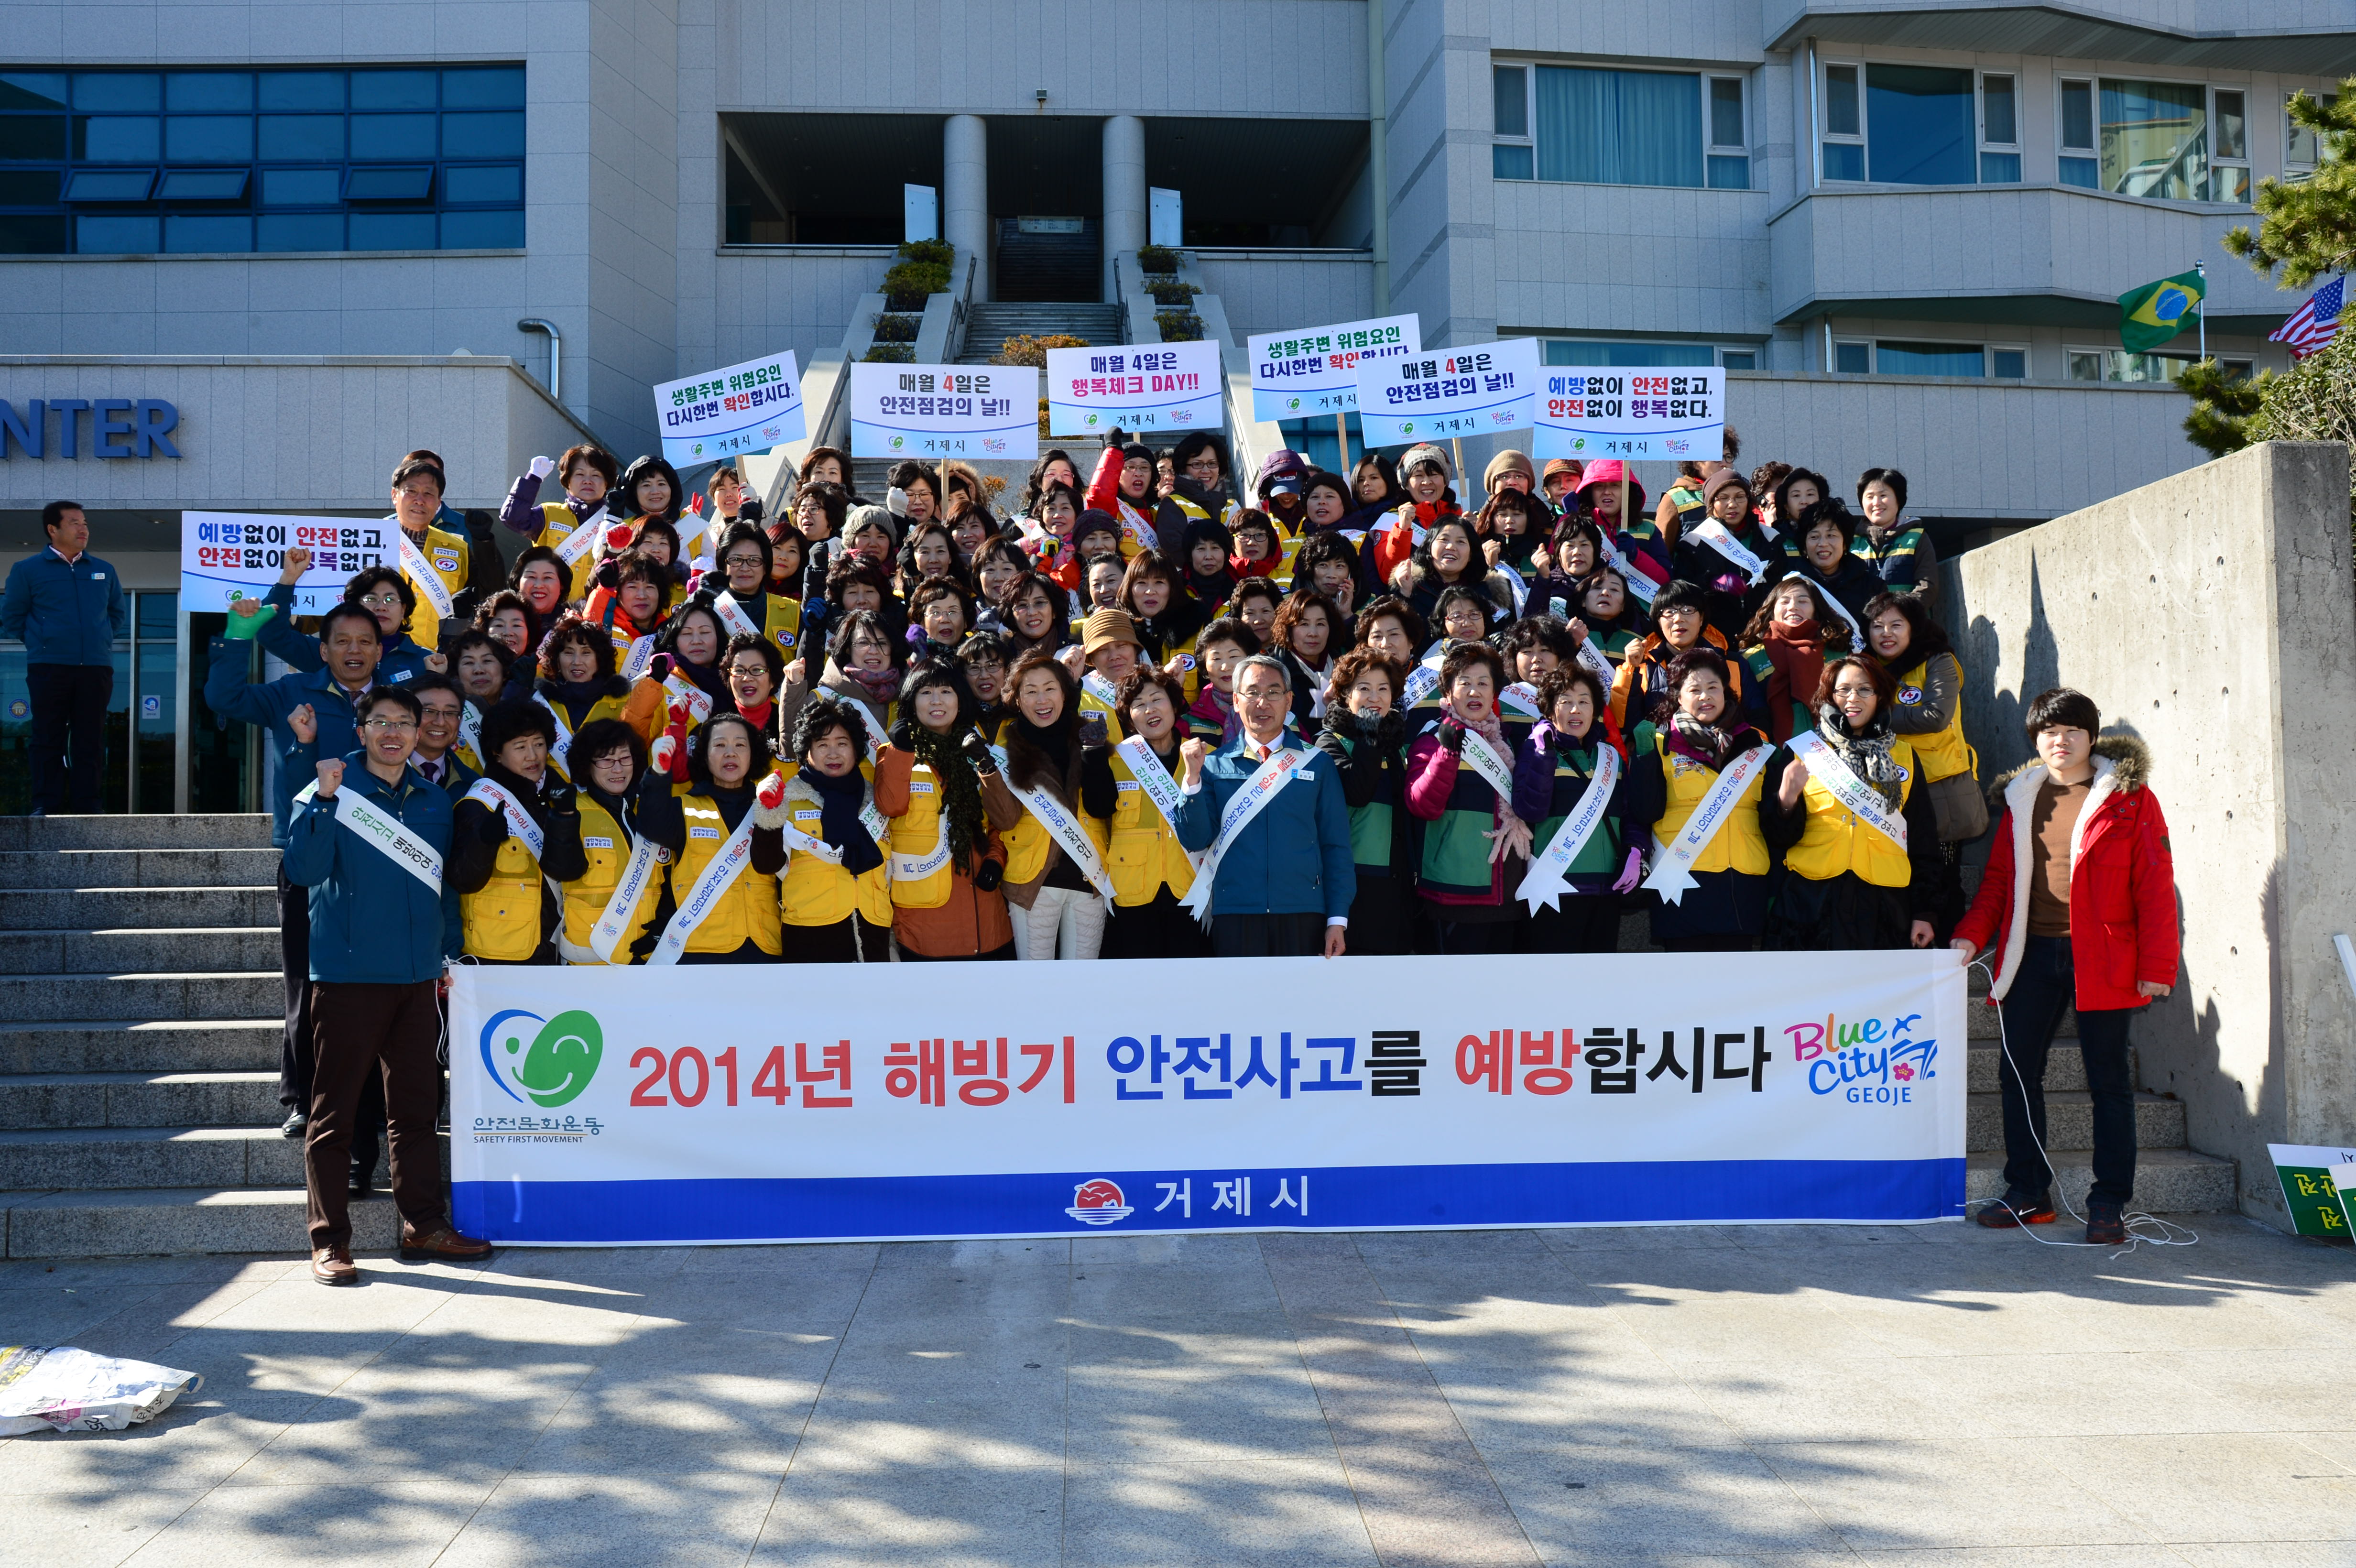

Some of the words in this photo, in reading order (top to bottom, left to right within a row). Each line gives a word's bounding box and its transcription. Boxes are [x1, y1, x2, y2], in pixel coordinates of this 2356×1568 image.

[1268, 336, 1331, 359] 생활주변
[1338, 326, 1400, 349] 위험요인
[1091, 355, 1124, 373] 매월
[1132, 352, 1177, 370] 4일은
[1260, 357, 1322, 379] 다시한번
[1402, 360, 1438, 380] 매월
[1445, 353, 1492, 374] 4일은
[672, 379, 724, 406] 생활주변
[730, 364, 782, 391] 위험요인
[899, 374, 935, 392] 매월
[943, 375, 991, 393] 4일은
[1071, 376, 1144, 397] 행복체크
[1152, 373, 1199, 392] DAY!!
[1386, 377, 1476, 404] 안전점검의
[1484, 372, 1515, 392] 날!!
[1549, 377, 1623, 395] 예방없이
[1632, 377, 1712, 395] 안전없고,
[667, 401, 720, 426] 다시한번
[724, 382, 794, 412] 확인합시다.
[880, 396, 971, 416] 안전점검의
[981, 399, 1010, 416] 날!!
[1548, 399, 1622, 418] 안전없이
[1631, 400, 1712, 418] 행복없다.
[199, 523, 286, 545] 예방없이
[296, 526, 386, 549] 안전없고,
[198, 546, 284, 569] 안전없이
[411, 559, 445, 600] 안전점검의
[1277, 753, 1297, 773] 매월
[1470, 743, 1501, 777] 안전없고
[1136, 766, 1168, 806] 안전없이
[1250, 772, 1278, 799] 4일은
[1727, 763, 1747, 788] 4일은
[1572, 786, 1605, 837] 안전점검의
[1695, 786, 1732, 832] 안전점검의
[352, 807, 395, 841] 안전사고
[393, 836, 433, 869] 예방하여
[1034, 794, 1066, 829] 안전문화
[1063, 827, 1092, 861] 정착하자
[1688, 831, 1701, 844] 날
[725, 838, 750, 867] 4일은
[1563, 836, 1575, 849] 날
[622, 849, 650, 903] 안전점검의
[903, 863, 914, 873] 날
[688, 865, 729, 917] 안전점검의
[615, 902, 627, 916] 날
[678, 915, 691, 928] 날
[1783, 1013, 1887, 1061] Blue
[630, 1039, 853, 1108] 2014년
[884, 1036, 1075, 1107] 해빙기
[1106, 1030, 1428, 1101] 안전사고를
[1454, 1026, 1772, 1096] 예방합시다
[1808, 1046, 1889, 1096] City
[1846, 1087, 1912, 1106] GEOJE
[473, 1115, 604, 1135] 안전문화운동
